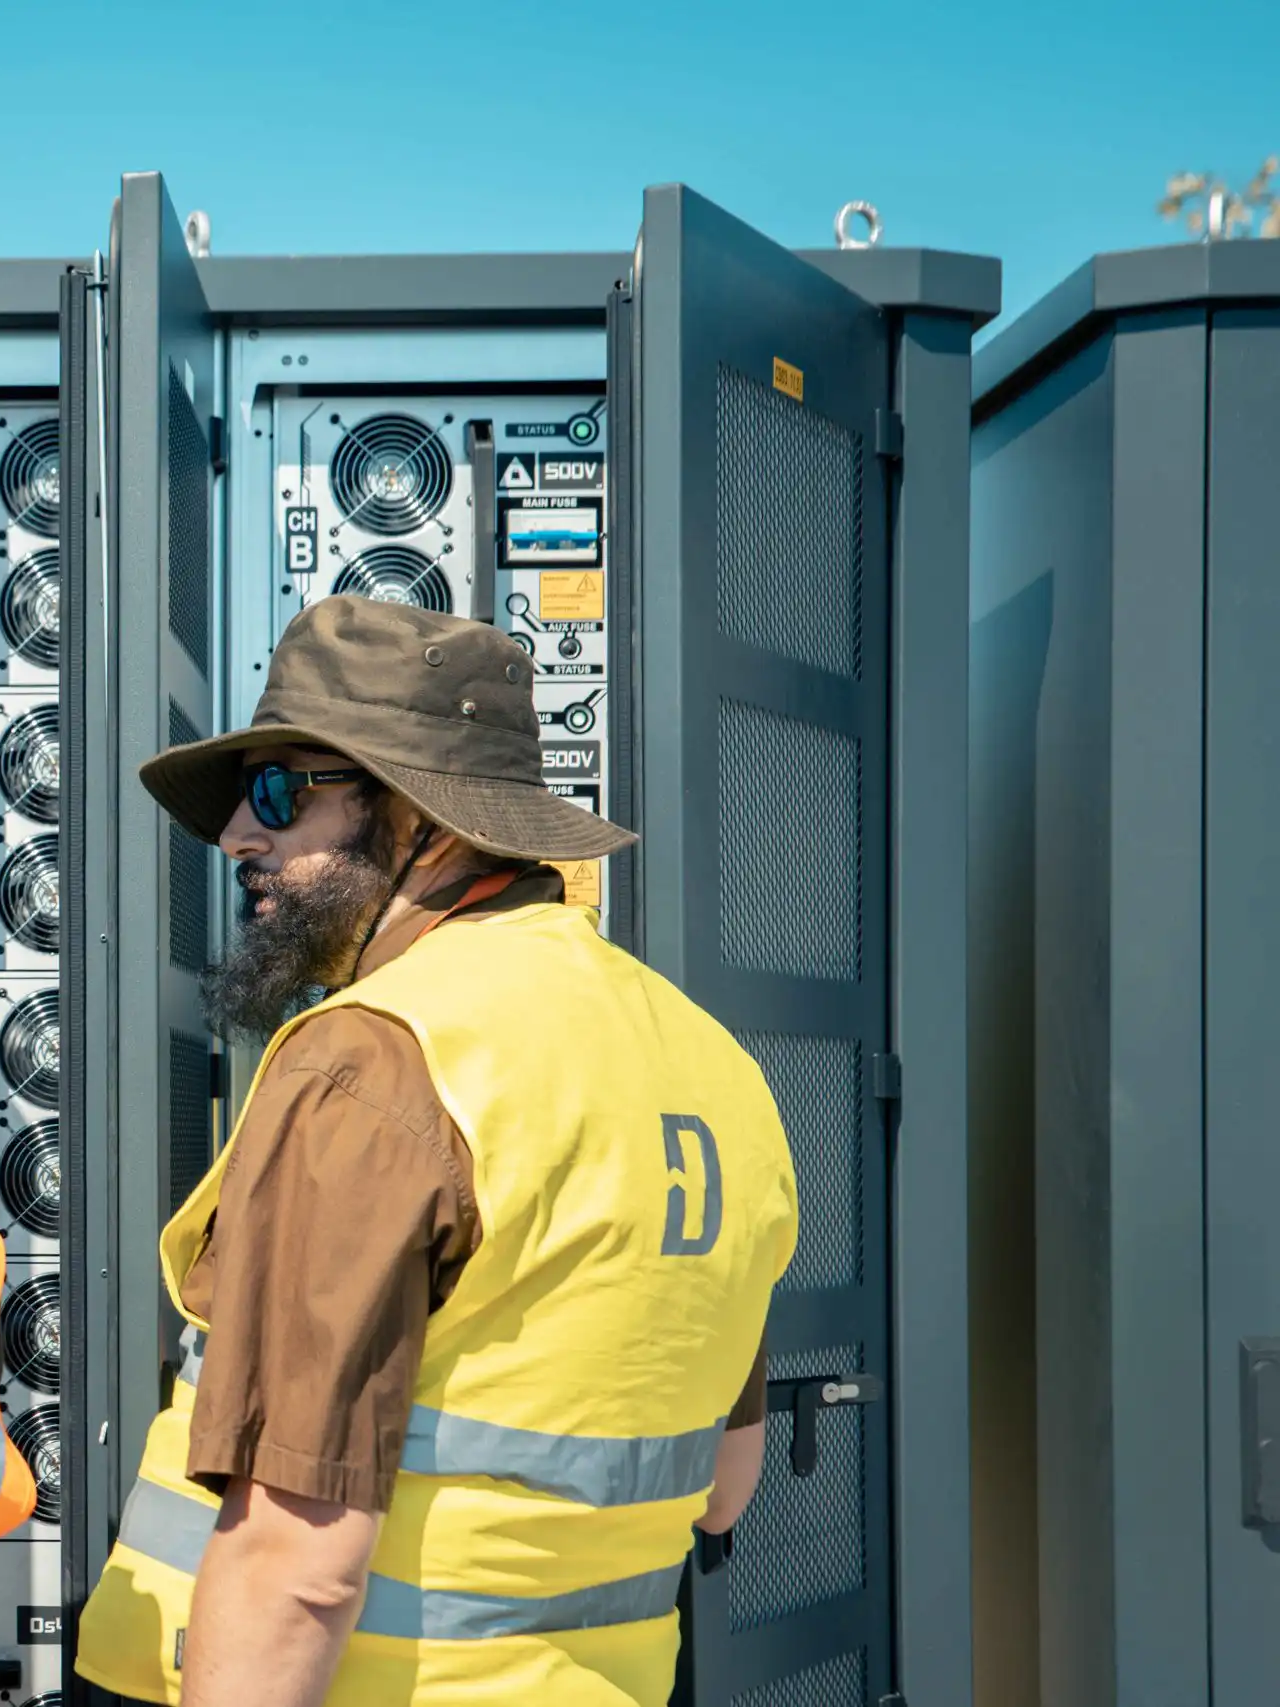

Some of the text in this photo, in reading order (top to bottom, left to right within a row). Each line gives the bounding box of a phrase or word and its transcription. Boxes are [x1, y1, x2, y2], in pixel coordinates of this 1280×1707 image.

[518, 425, 555, 435] STATUS
[545, 462, 597, 480] 500V
[523, 498, 578, 508] MAIN FUSE
[288, 511, 316, 532] CH
[290, 535, 314, 569] B
[548, 623, 597, 632] AUX FUSE
[553, 665, 591, 674] STATUS
[542, 750, 595, 768] 500V
